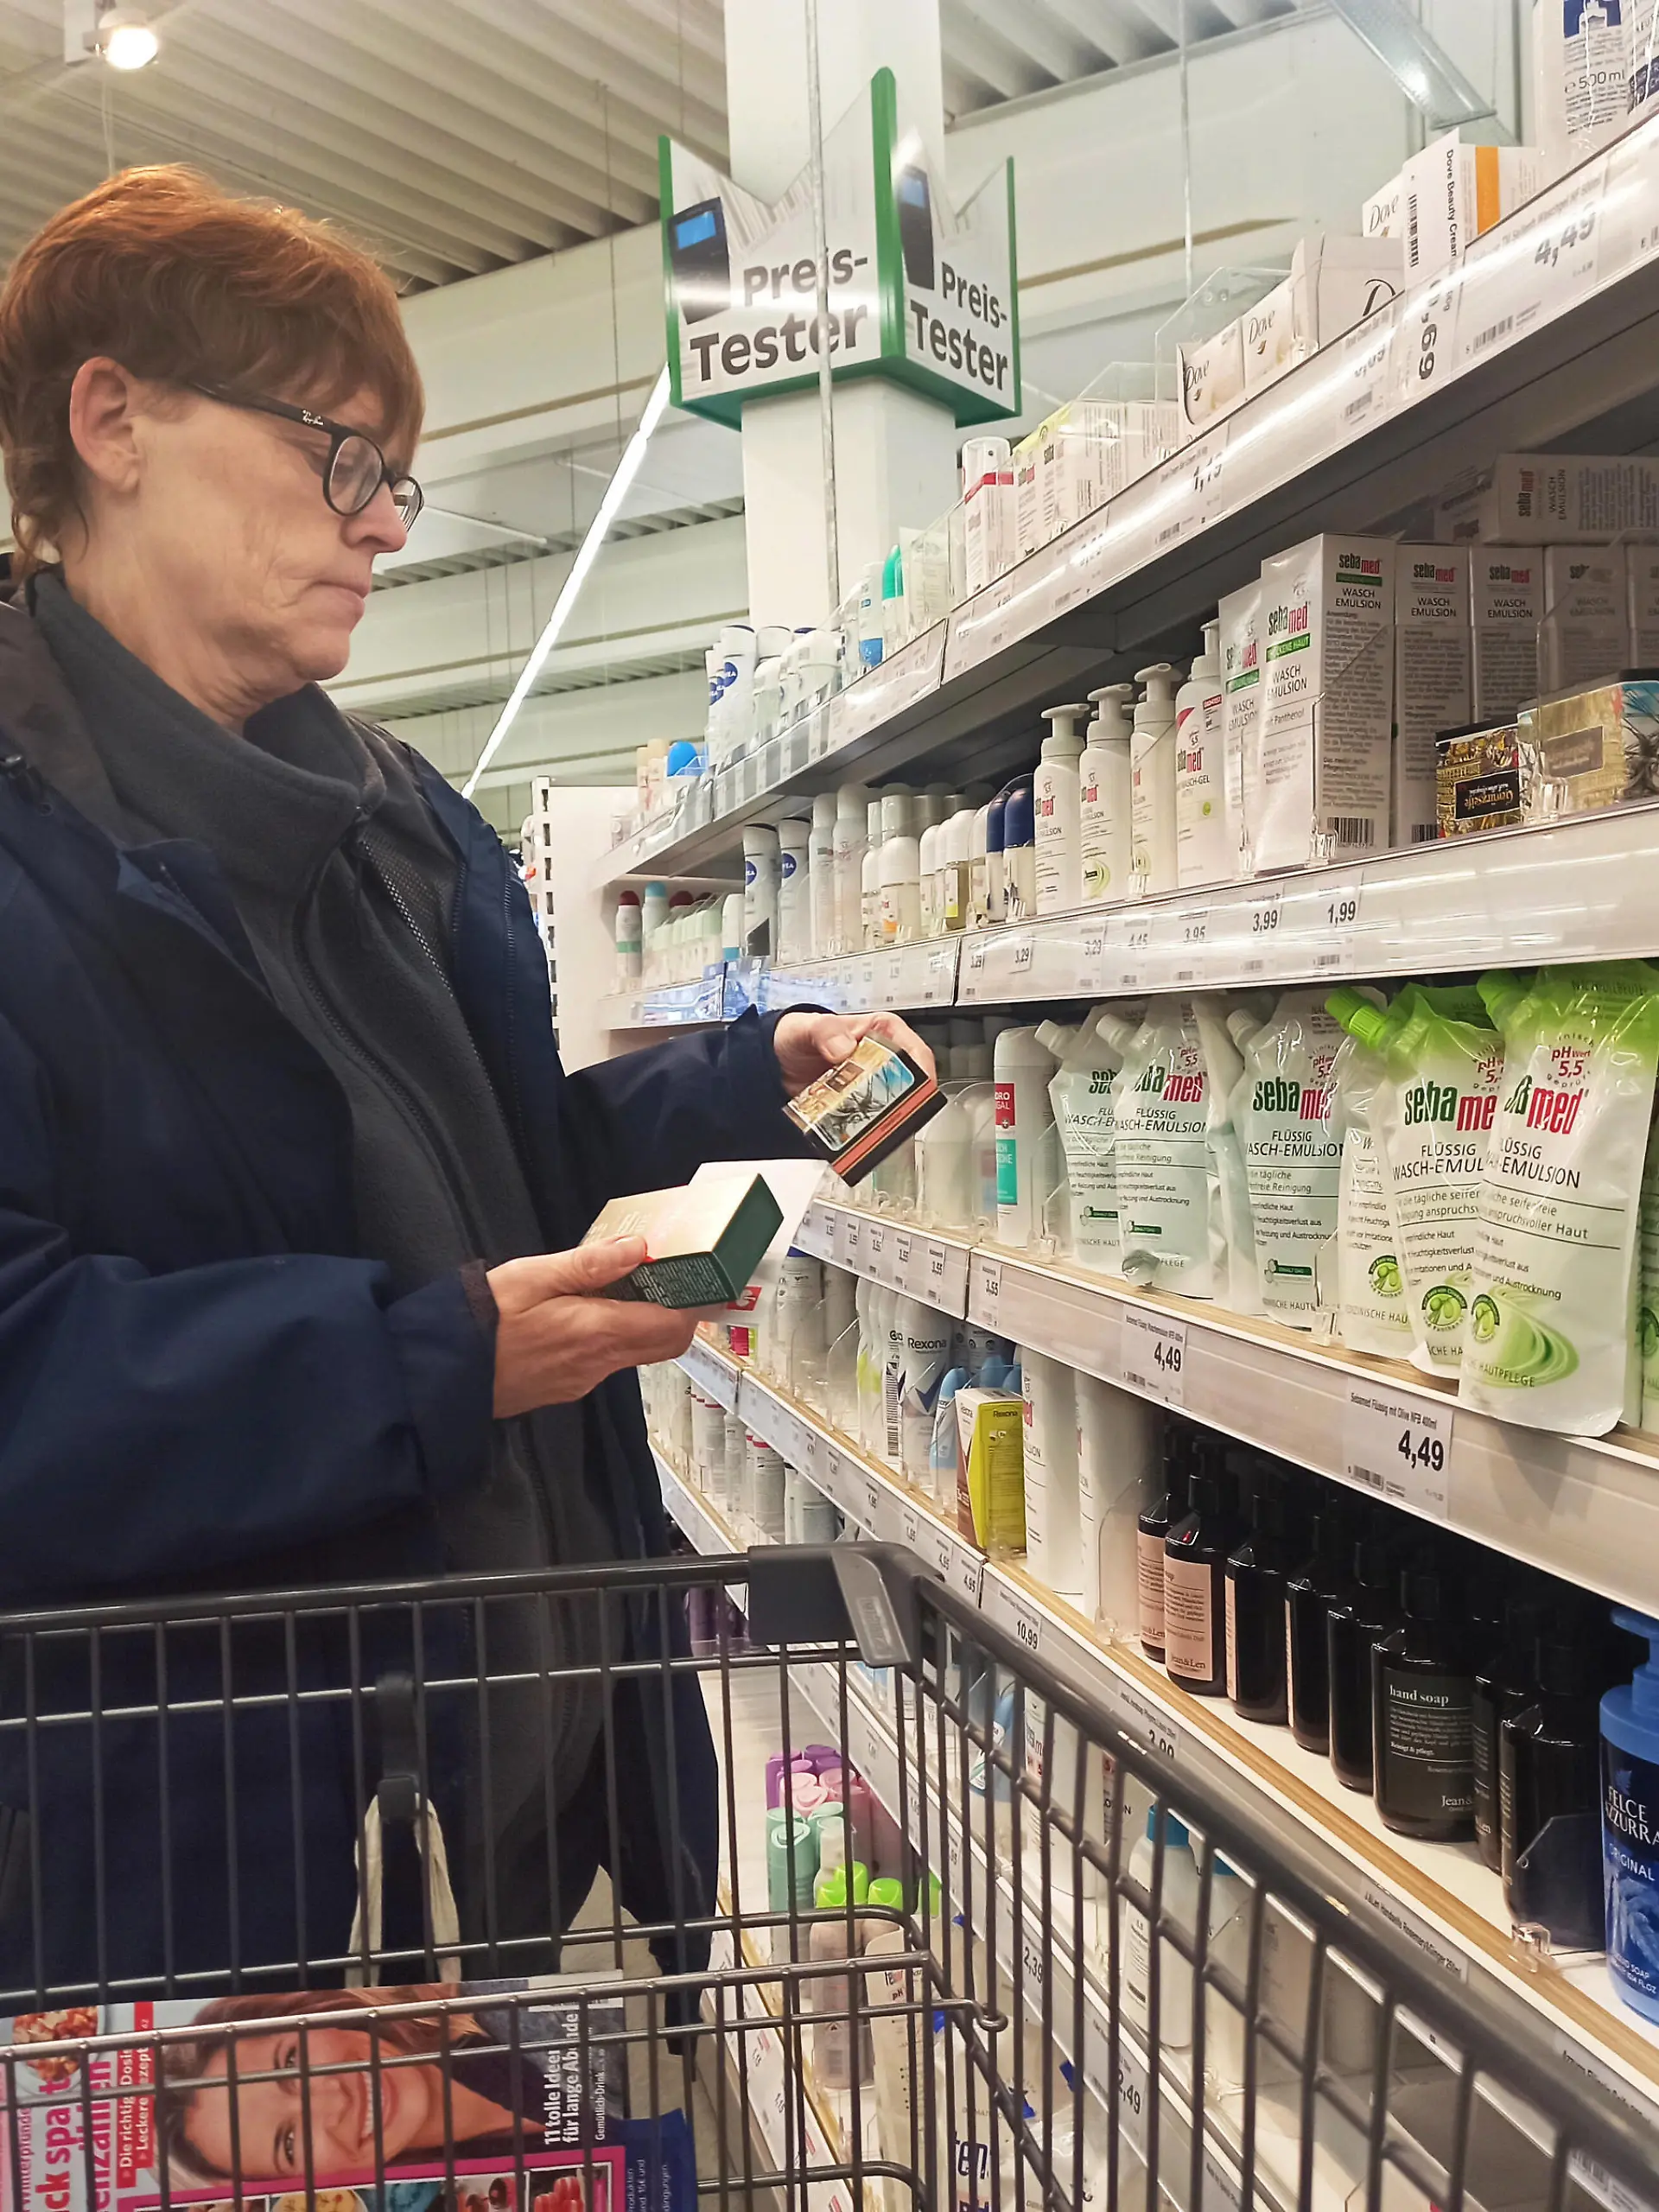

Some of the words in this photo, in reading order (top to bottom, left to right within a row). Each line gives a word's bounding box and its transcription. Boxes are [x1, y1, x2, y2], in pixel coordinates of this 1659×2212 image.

[1579, 72, 1607, 89] 500
[1609, 69, 1625, 82] ml
[1447, 181, 1456, 223] Beauty
[1370, 195, 1399, 232] Dove
[1534, 201, 1598, 268] 4,49
[941, 261, 1008, 329] Preis-
[1249, 310, 1275, 345] Dove
[690, 302, 869, 382] Tester
[910, 298, 1009, 391] Tester
[1185, 360, 1210, 390] Dove
[1517, 467, 1535, 518] sebamed
[1558, 468, 1567, 520] EMULSION
[1338, 553, 1381, 574] sebamed
[1414, 563, 1455, 583] sebamed
[1489, 564, 1531, 584] sebamed
[1335, 598, 1382, 609] EMULSION
[1342, 588, 1376, 598] WASCH
[1417, 597, 1450, 607] WASCH
[1494, 598, 1526, 607] WASCH
[1268, 601, 1310, 636] sebamed
[1411, 607, 1457, 618] EMULSION
[1487, 608, 1533, 619] EMULSION
[1272, 664, 1301, 683] WASCH
[1253, 909, 1278, 933] 3,99
[1328, 900, 1357, 927] 1,99
[1551, 1046, 1571, 1062] pH
[1478, 1057, 1496, 1073] pH
[1558, 1060, 1584, 1077] 5,5
[1134, 1065, 1204, 1103] bamed
[1485, 1069, 1503, 1084] 5,
[995, 1092, 1010, 1101] DRO
[1404, 1080, 1498, 1131] sebame
[1136, 1108, 1177, 1120] FLÜSSIG
[1115, 1120, 1206, 1133] ASCH-EMULSIO
[1272, 1129, 1313, 1141] FLÜSSIG
[1249, 1143, 1343, 1157] ASCH-EMULSIO
[1421, 1142, 1477, 1157] FLÜSSIG
[1499, 1139, 1542, 1160] LÜSSIG
[1393, 1158, 1484, 1181] WASCH-EMUL
[1272, 1183, 1312, 1194] Reinigung
[1414, 1190, 1447, 1205] tägliche
[1426, 1205, 1479, 1218] anspruchsv
[1556, 1224, 1588, 1240] Haut
[1448, 1262, 1464, 1271] und
[1517, 1264, 1529, 1273] aus
[907, 1337, 947, 1350] Rexona
[1154, 1341, 1181, 1372] 4,49
[1478, 1363, 1535, 1388] HAUTPFLEGE
[1397, 1429, 1444, 1471] 4,49
[1015, 1618, 1039, 1651] 10,99
[1389, 1685, 1417, 1701] hand
[1420, 1693, 1449, 1707] soap
[1441, 1796, 1472, 1807] Jean&
[1608, 1784, 1646, 1823] FELCE
[1609, 1842, 1656, 1882] ORIGINAL
[562, 2013, 580, 2072] Abnde
[137, 2048, 153, 2084] ezept
[562, 2075, 582, 2117] lange
[118, 2094, 137, 2142] richtig
[543, 2091, 562, 2127] tolle
[136, 2097, 150, 2151] Leckere
[562, 2121, 580, 2144] für
[544, 2129, 562, 2145] 11
[119, 2144, 133, 2168] Die
[637, 2158, 646, 2177] und
[661, 2164, 672, 2212] dingungen
